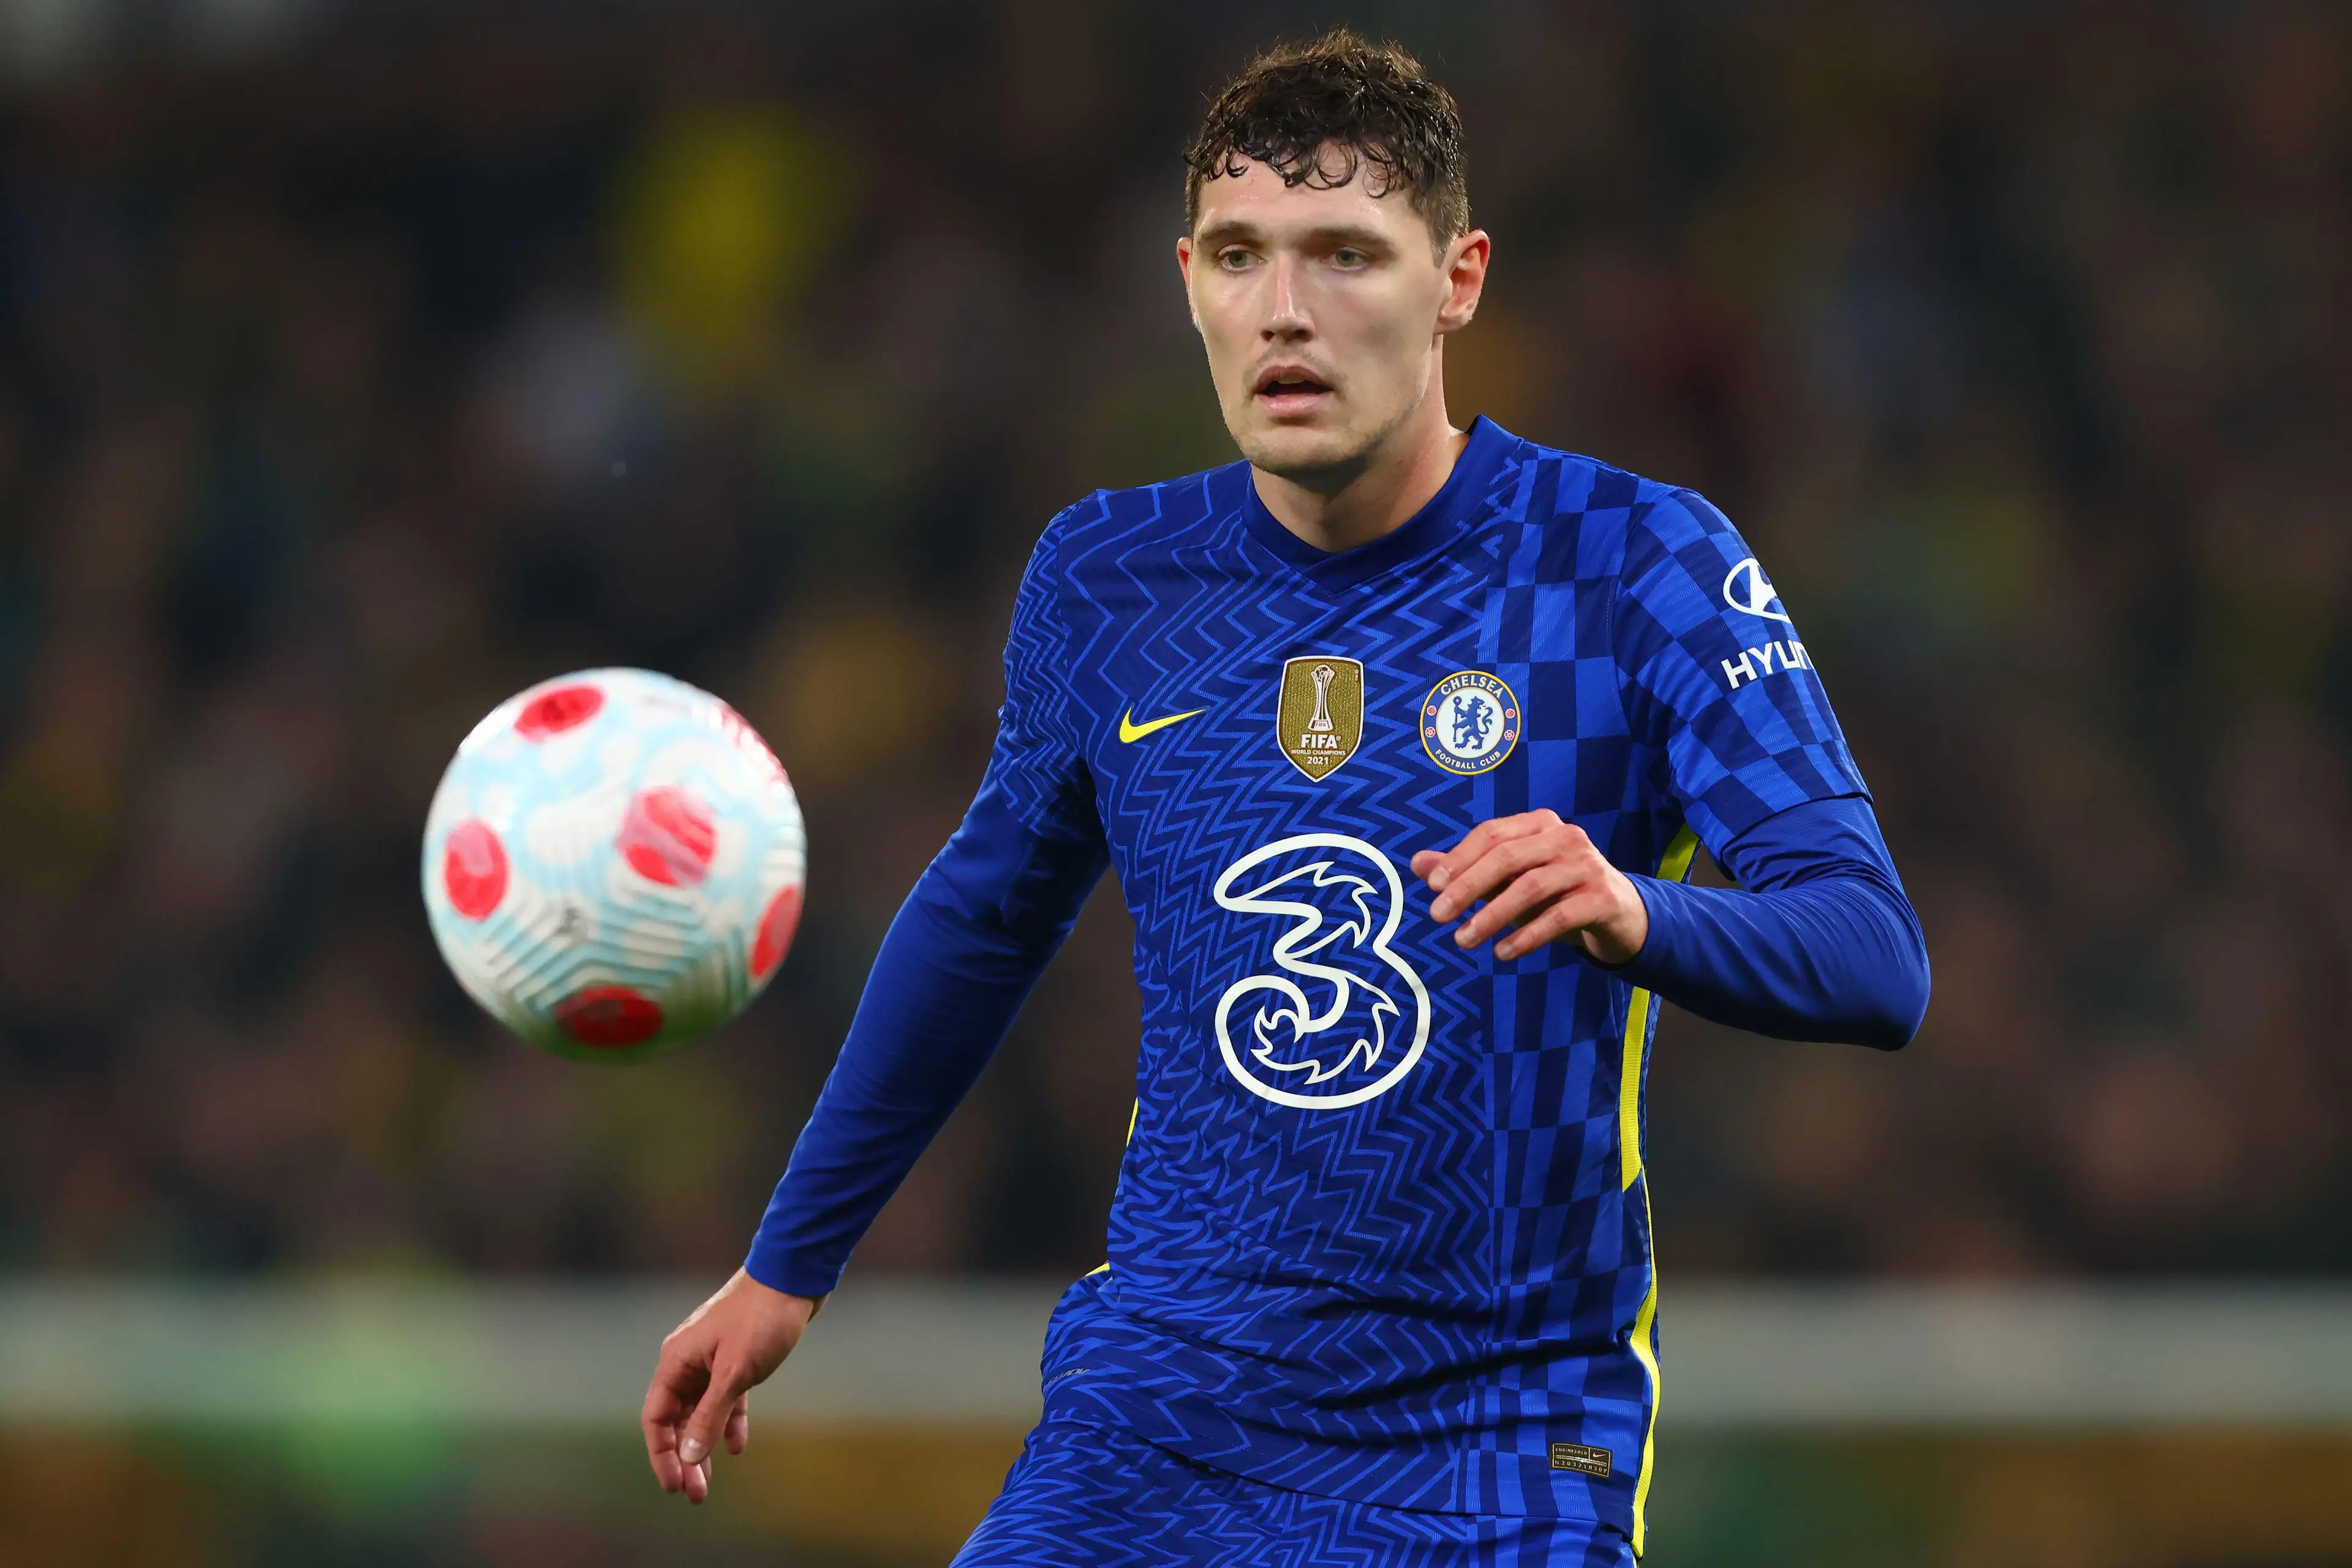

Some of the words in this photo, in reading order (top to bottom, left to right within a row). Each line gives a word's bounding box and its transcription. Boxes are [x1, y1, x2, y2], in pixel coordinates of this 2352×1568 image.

[1441, 674, 1504, 699] CHELSEA
[1436, 749, 1476, 769] FOOTBALL
[1480, 751, 1501, 766] CLUB
[1213, 833, 1431, 1109] 3
